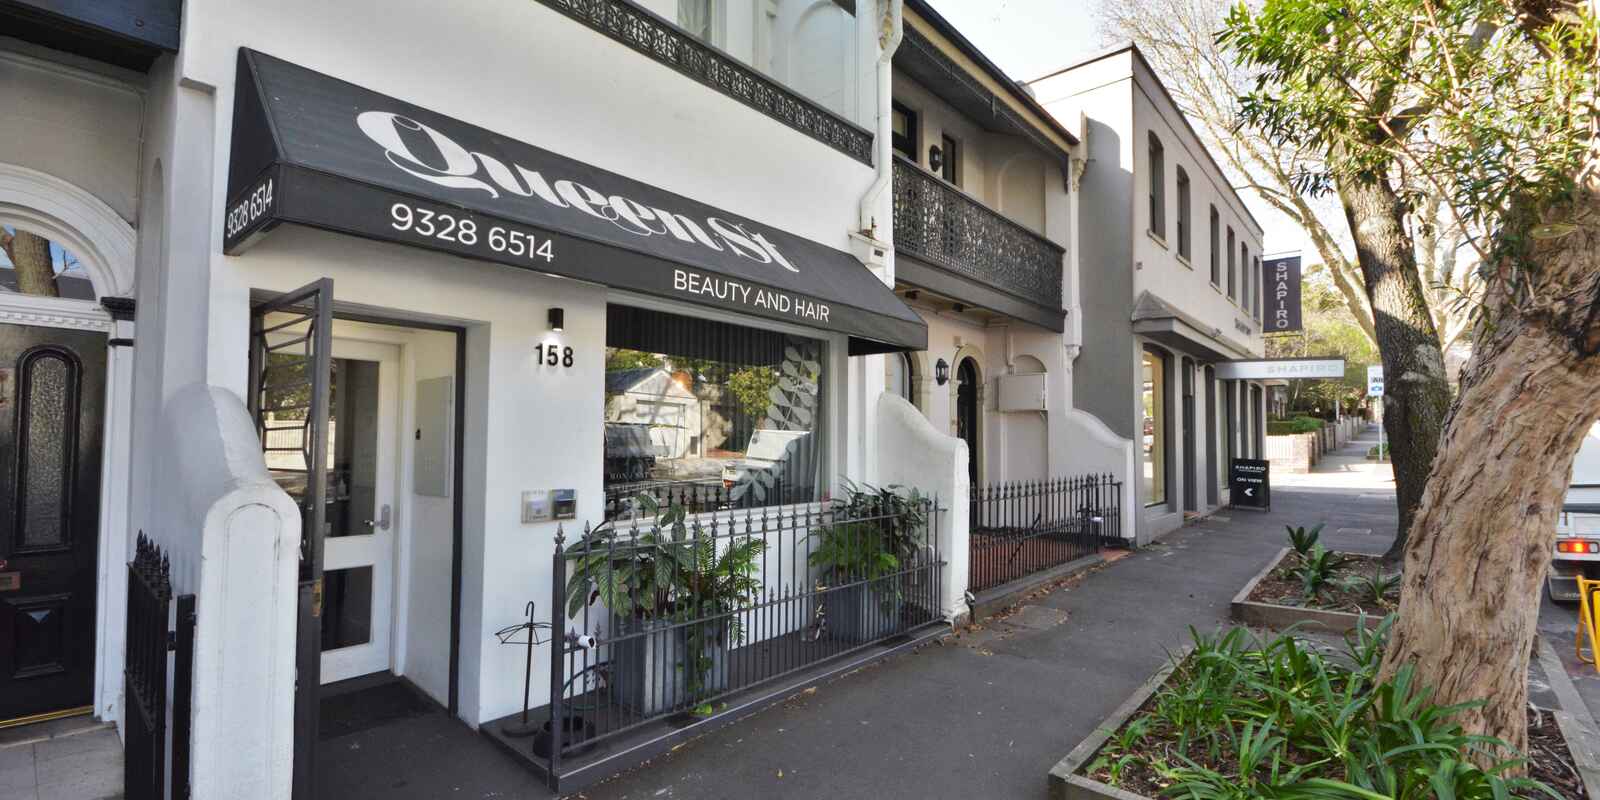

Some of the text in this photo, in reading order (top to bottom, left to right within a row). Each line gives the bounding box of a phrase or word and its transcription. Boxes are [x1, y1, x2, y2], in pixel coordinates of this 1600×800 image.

[227, 178, 273, 239] 9328 6514
[357, 111, 800, 273] Queen St
[391, 203, 554, 262] 9328 6514
[674, 269, 830, 323] BEAUTY AND HAIR
[1276, 262, 1289, 329] SHAPIRO
[534, 343, 574, 368] 158
[1266, 363, 1338, 375] SHAPIRO
